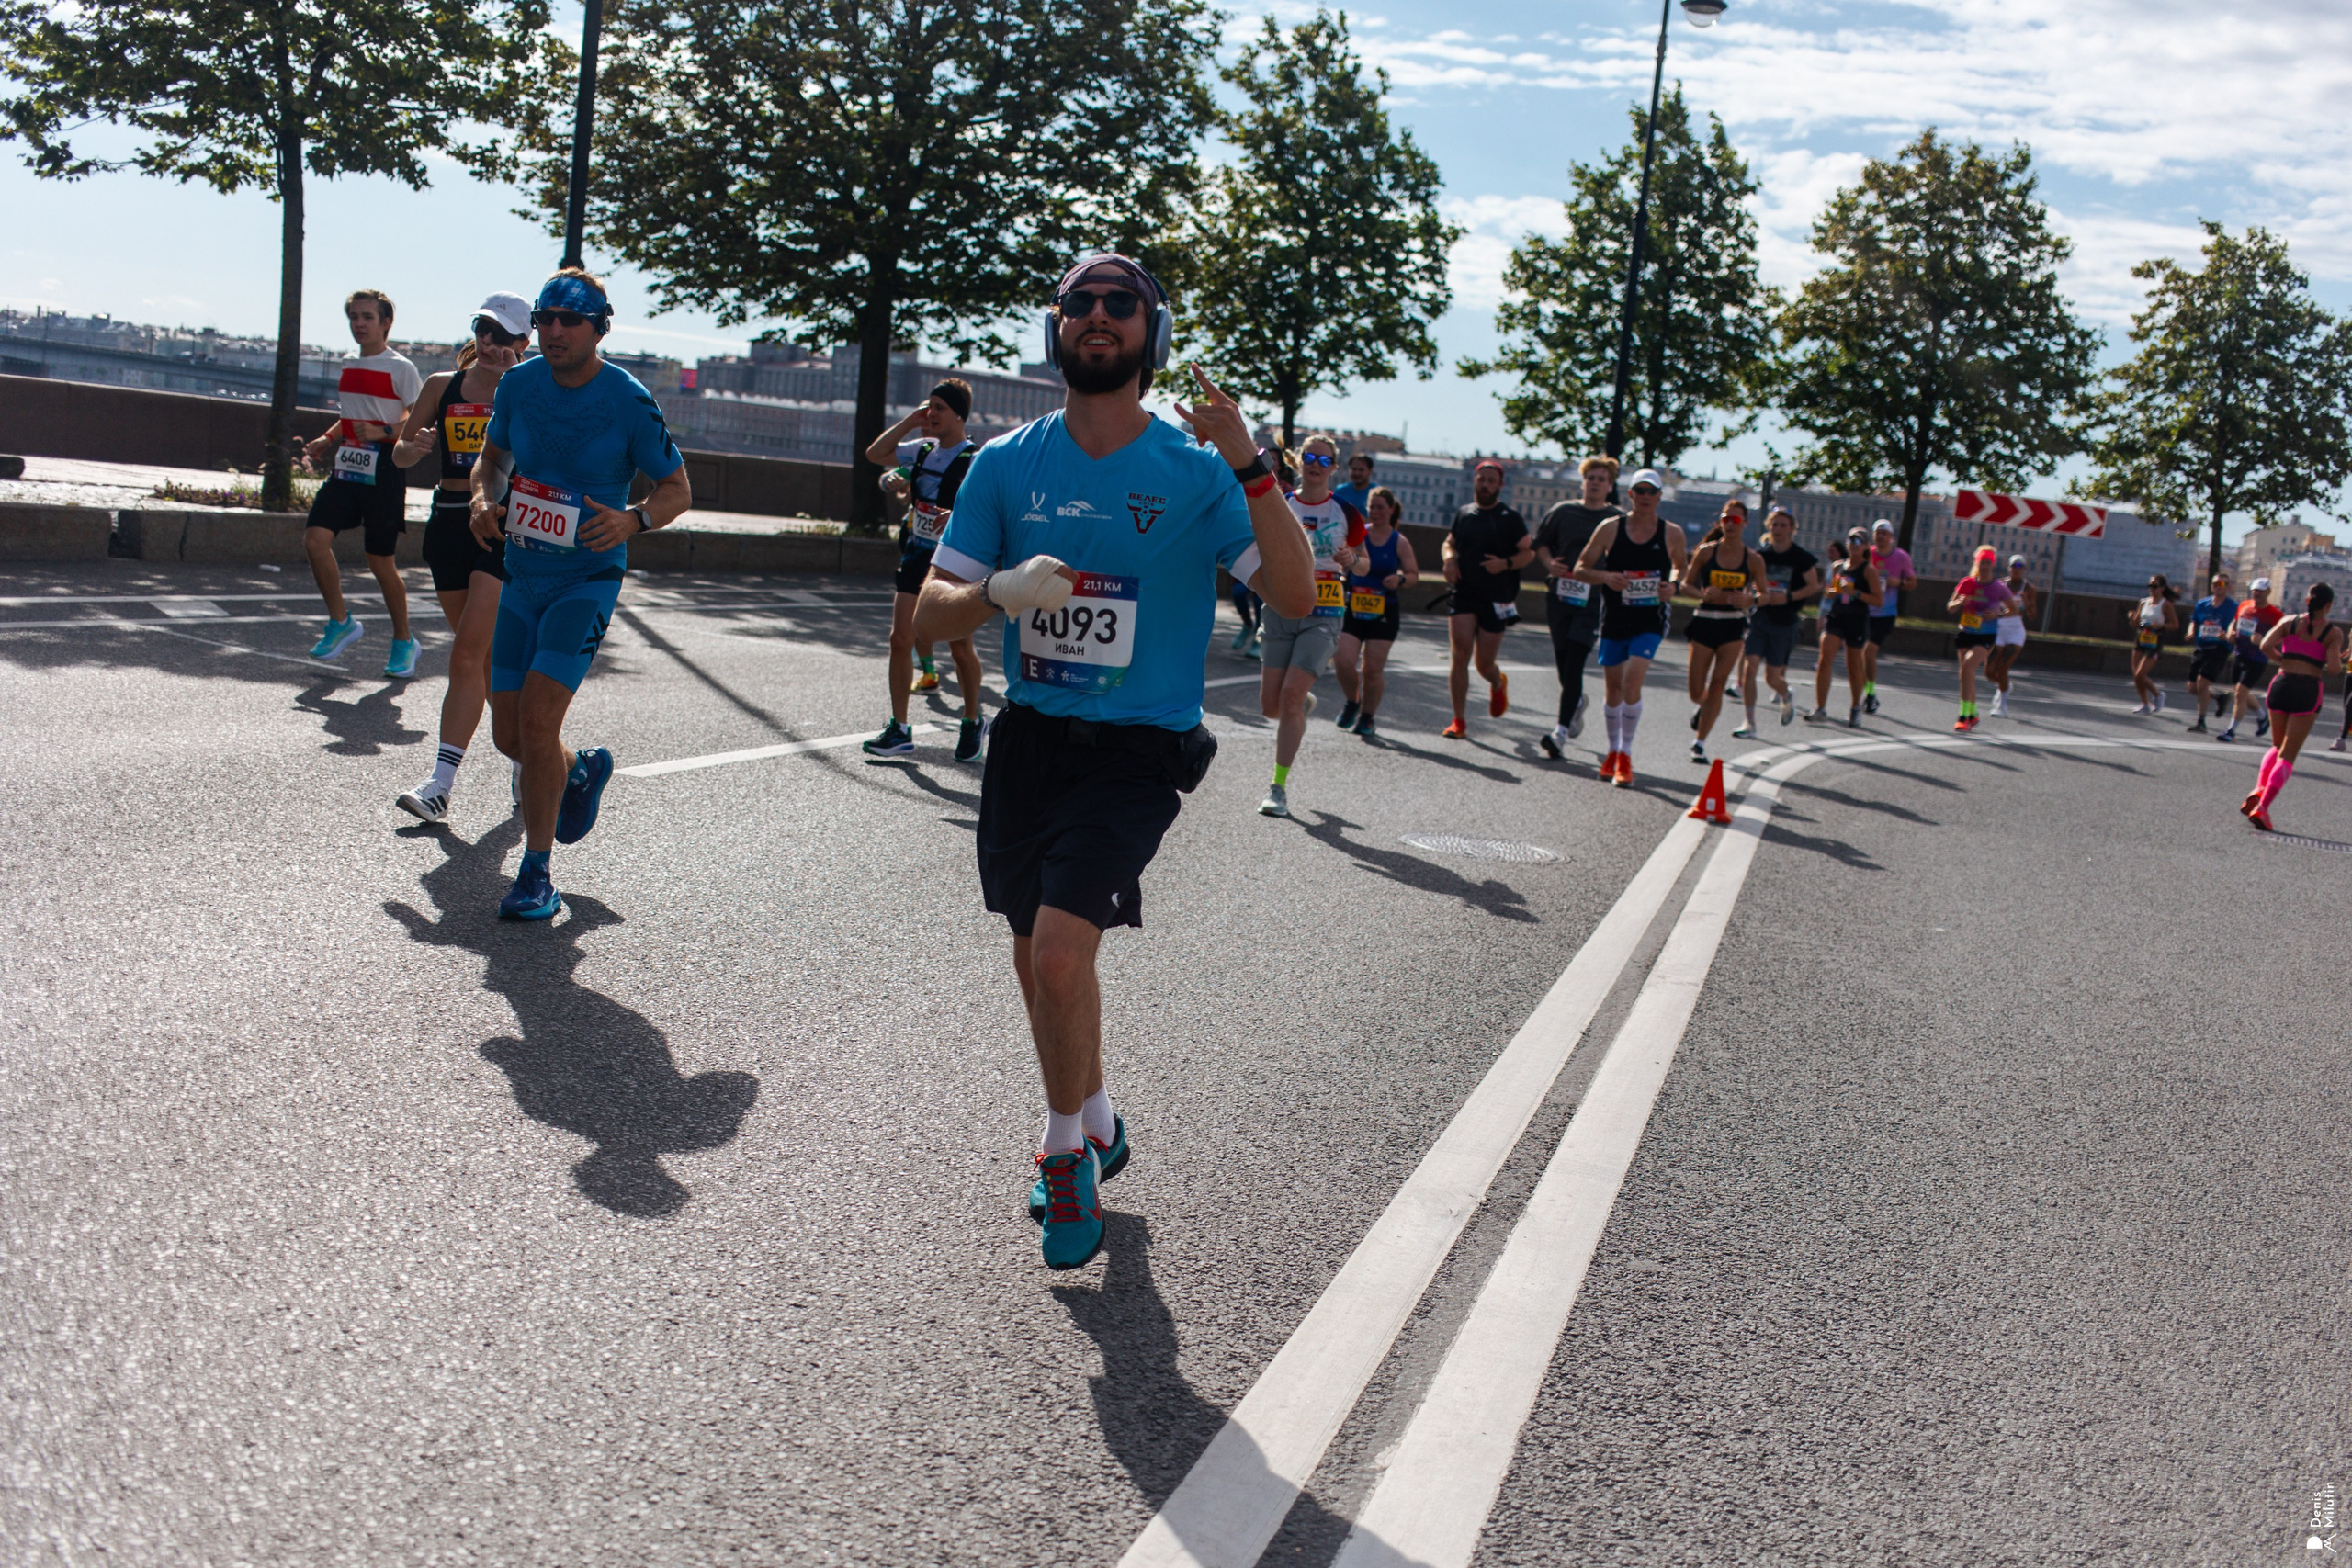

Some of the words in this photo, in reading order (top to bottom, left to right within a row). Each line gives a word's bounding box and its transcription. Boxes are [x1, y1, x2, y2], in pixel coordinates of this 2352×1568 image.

[454, 422, 488, 441] 546
[340, 450, 371, 467] 6408
[456, 454, 462, 464] E
[1128, 492, 1167, 504] ВЕЛЕС
[515, 502, 567, 536] 7200
[917, 514, 934, 532] 725
[1021, 512, 1050, 523] JÖGEL
[1083, 580, 1102, 591] 21,1
[1317, 584, 1339, 598] 174
[1355, 595, 1381, 608] 1047
[1031, 606, 1118, 644] 4093
[1055, 643, 1085, 656] ИВАН
[1029, 658, 1038, 678] E
